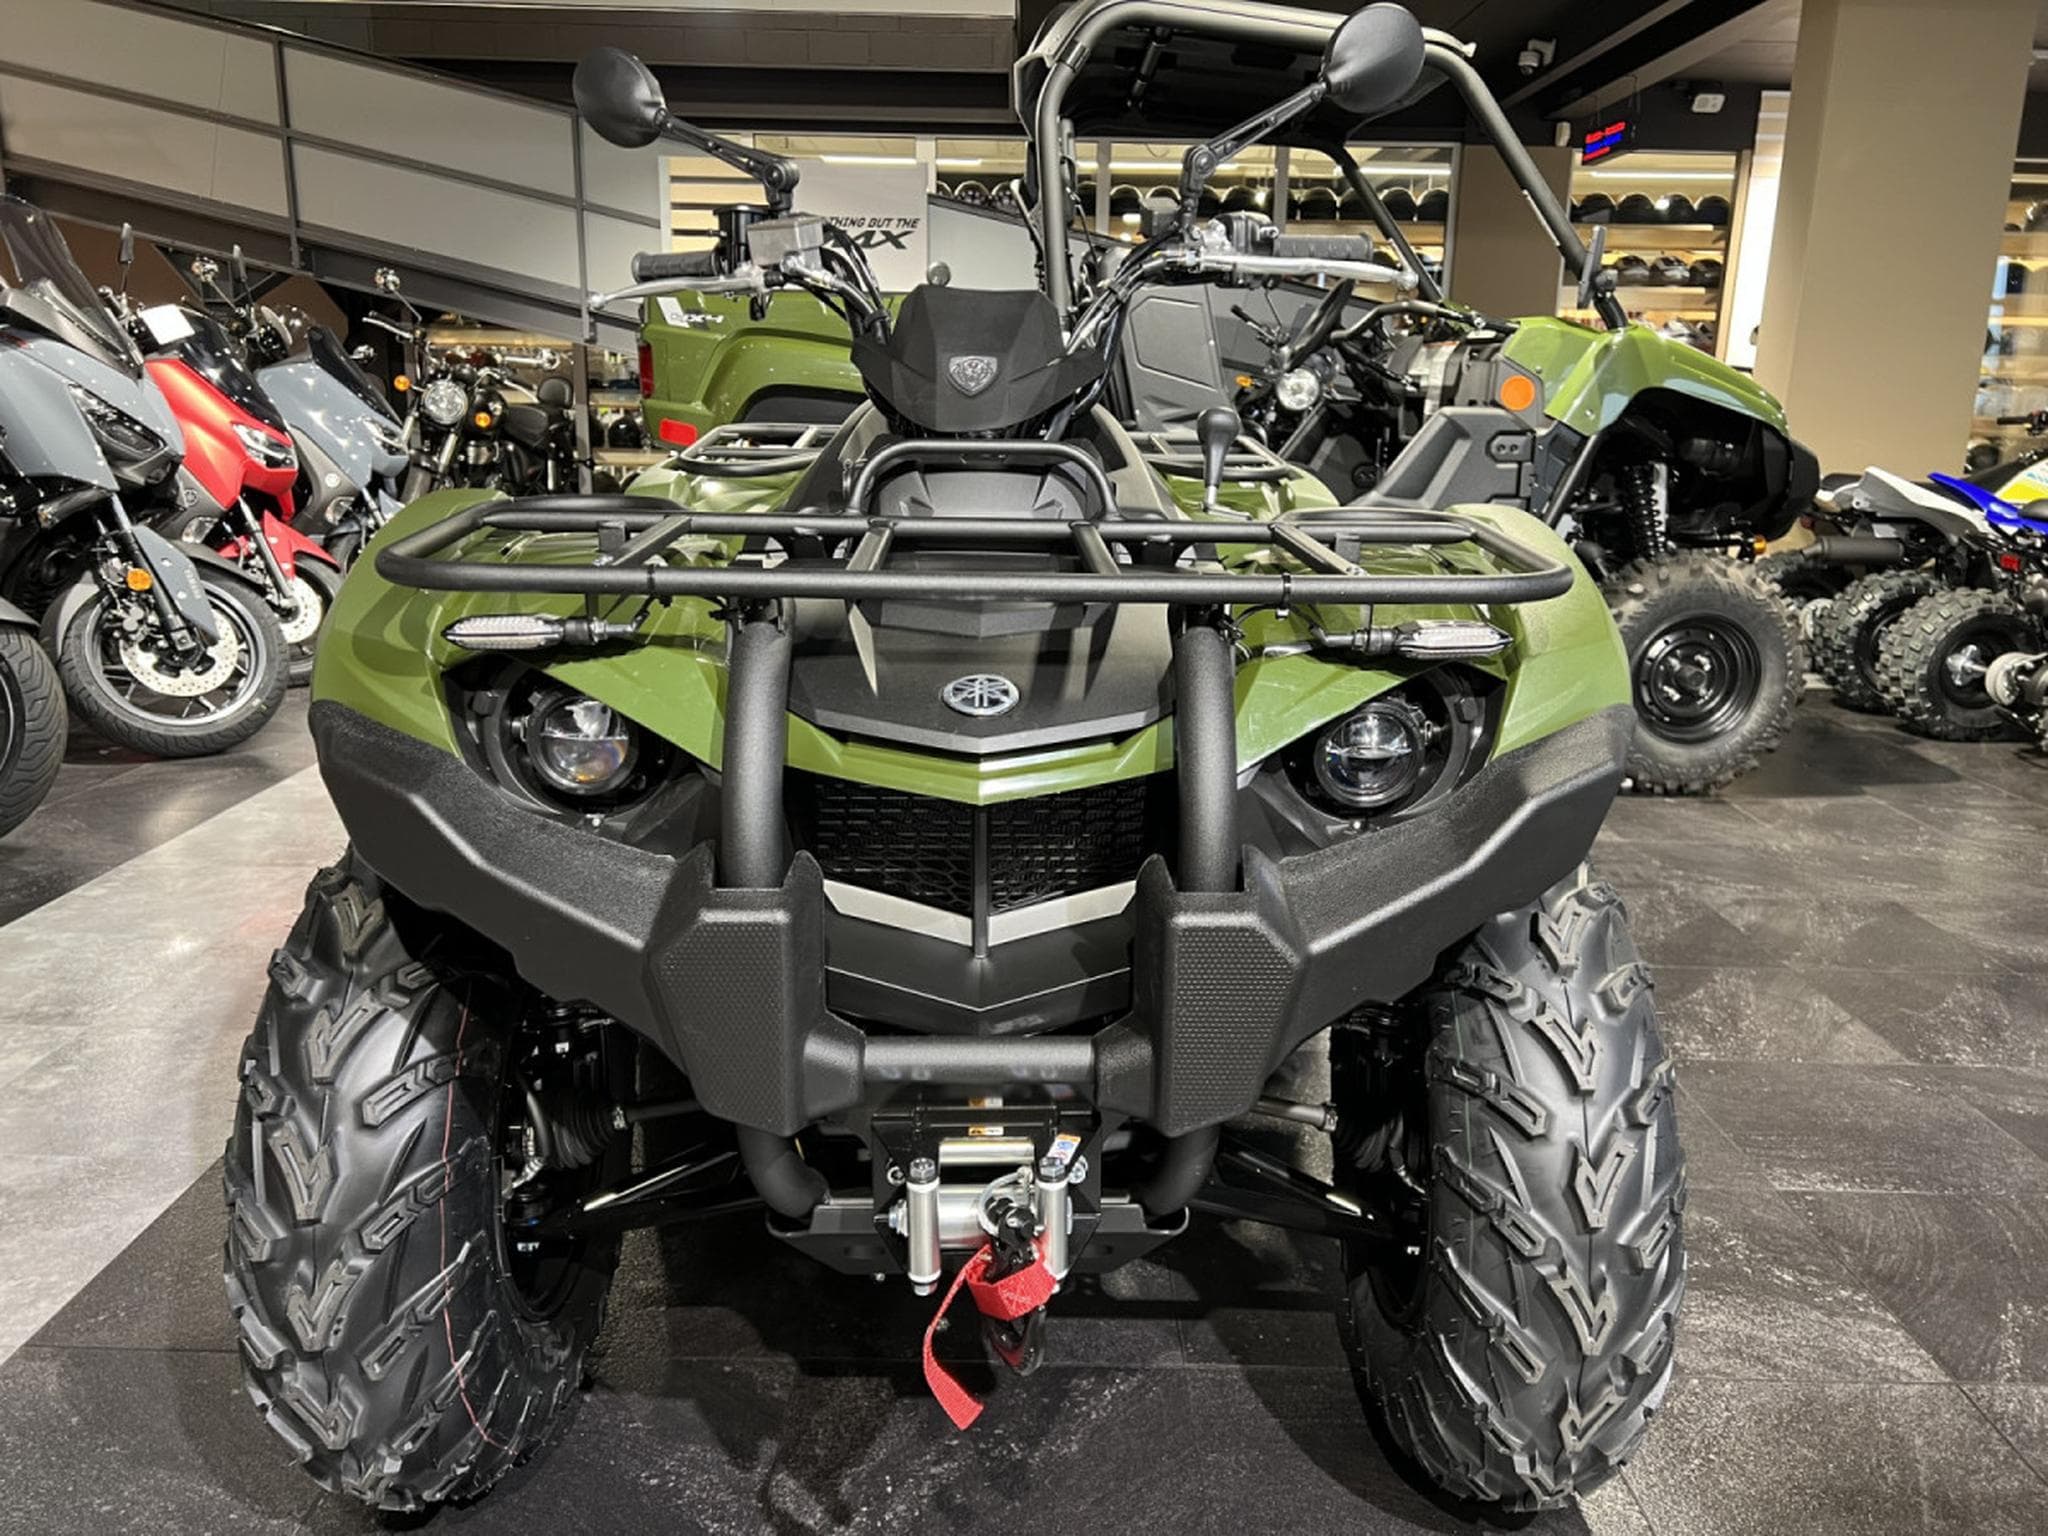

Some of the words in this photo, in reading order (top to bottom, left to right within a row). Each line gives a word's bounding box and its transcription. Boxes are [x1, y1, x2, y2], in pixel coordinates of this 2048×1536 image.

[827, 216, 866, 229] THING
[867, 217, 895, 229] BUT
[895, 217, 921, 230] THE
